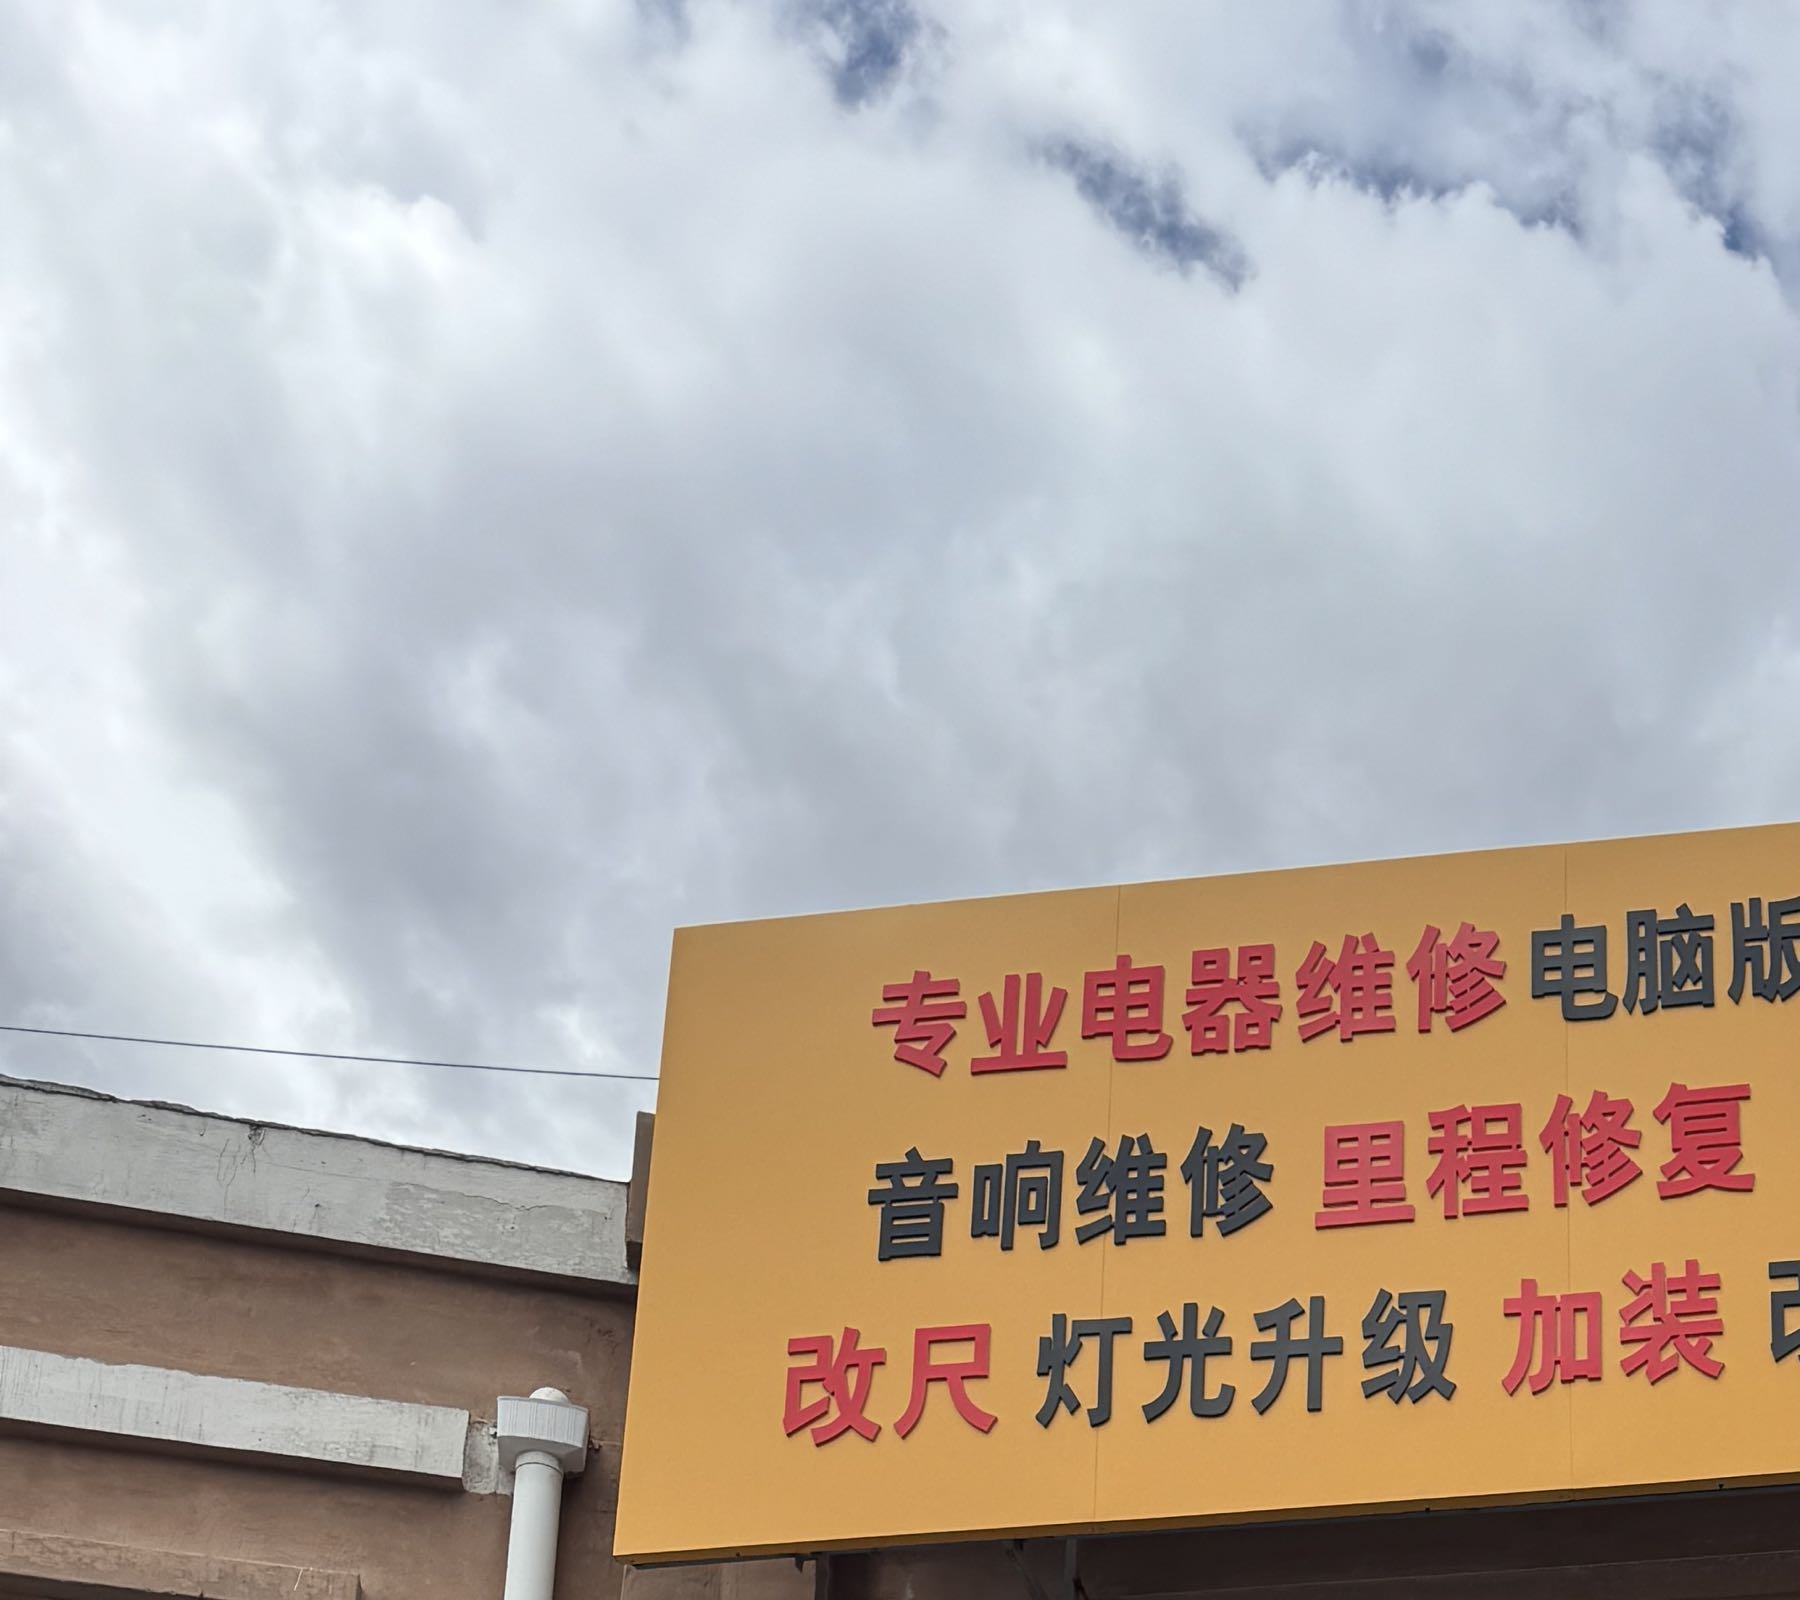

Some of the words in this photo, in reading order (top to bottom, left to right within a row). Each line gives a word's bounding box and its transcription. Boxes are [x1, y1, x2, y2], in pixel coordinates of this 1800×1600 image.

[871, 921, 1508, 1077] 专业电器维修
[867, 1124, 1275, 1262] 音响维修
[1315, 1082, 1757, 1234] 里程修复
[781, 1322, 998, 1447] 改尺
[1034, 1287, 1457, 1427] 灯光升级
[1501, 1259, 1727, 1398] 加装
